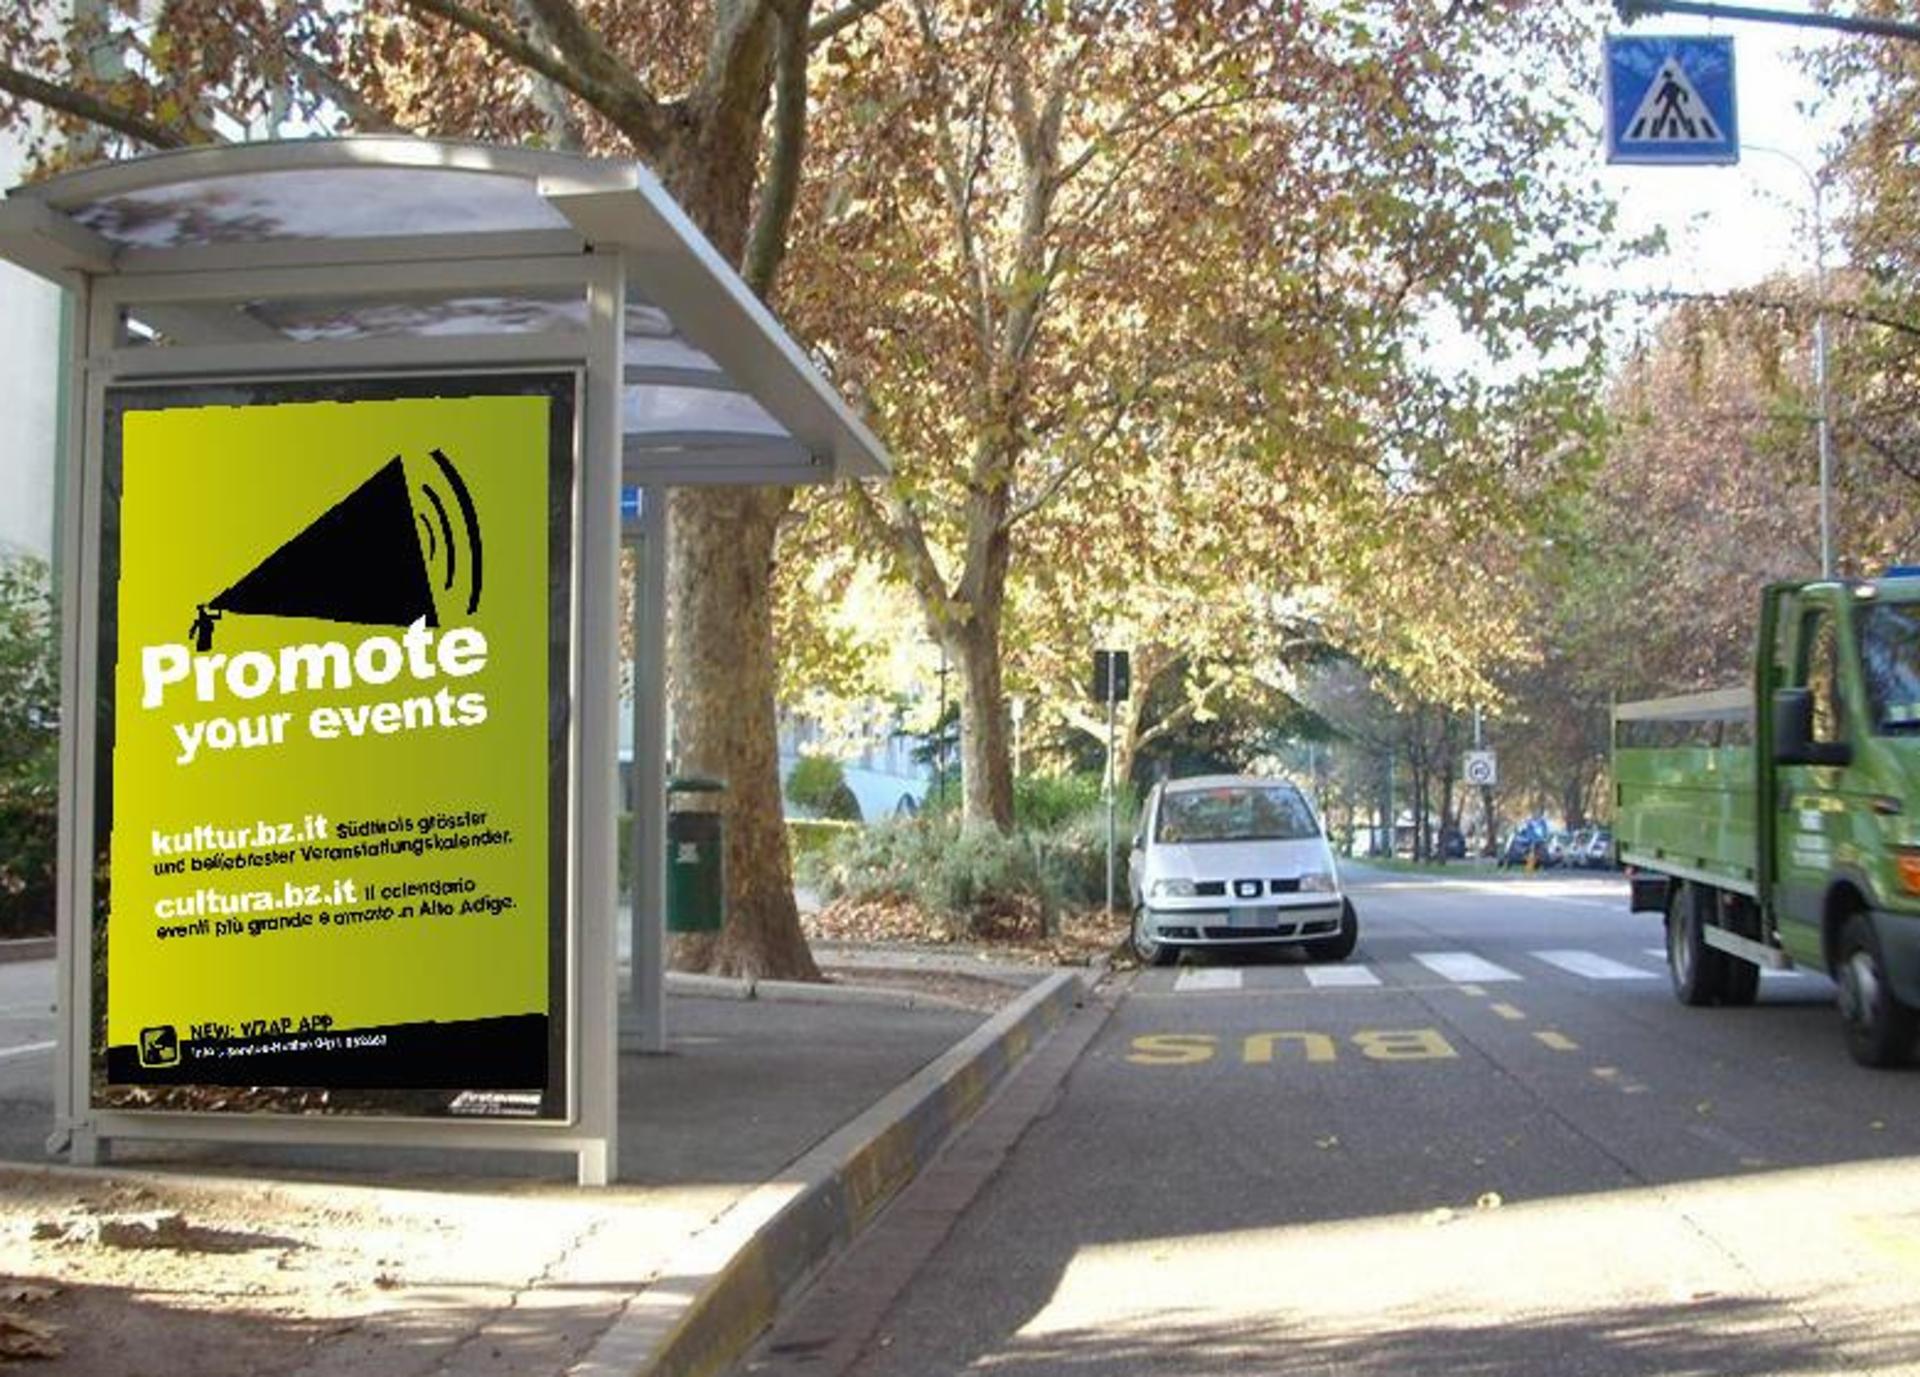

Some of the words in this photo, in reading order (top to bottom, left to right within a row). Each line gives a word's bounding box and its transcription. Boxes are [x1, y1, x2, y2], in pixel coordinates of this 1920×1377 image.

[142, 614, 489, 709] Promote
[173, 710, 292, 766] your
[309, 686, 489, 740] events
[152, 813, 328, 857] kultur.bz.it
[417, 811, 487, 834] grösster
[154, 857, 186, 876] und
[191, 848, 296, 872] beliebtester
[154, 878, 358, 919] cultura.bz.it
[380, 876, 476, 901] calendario
[157, 919, 210, 940] eventi
[248, 911, 314, 936] grande
[419, 899, 454, 917] Alto
[1125, 1029, 1459, 1065] BUS
